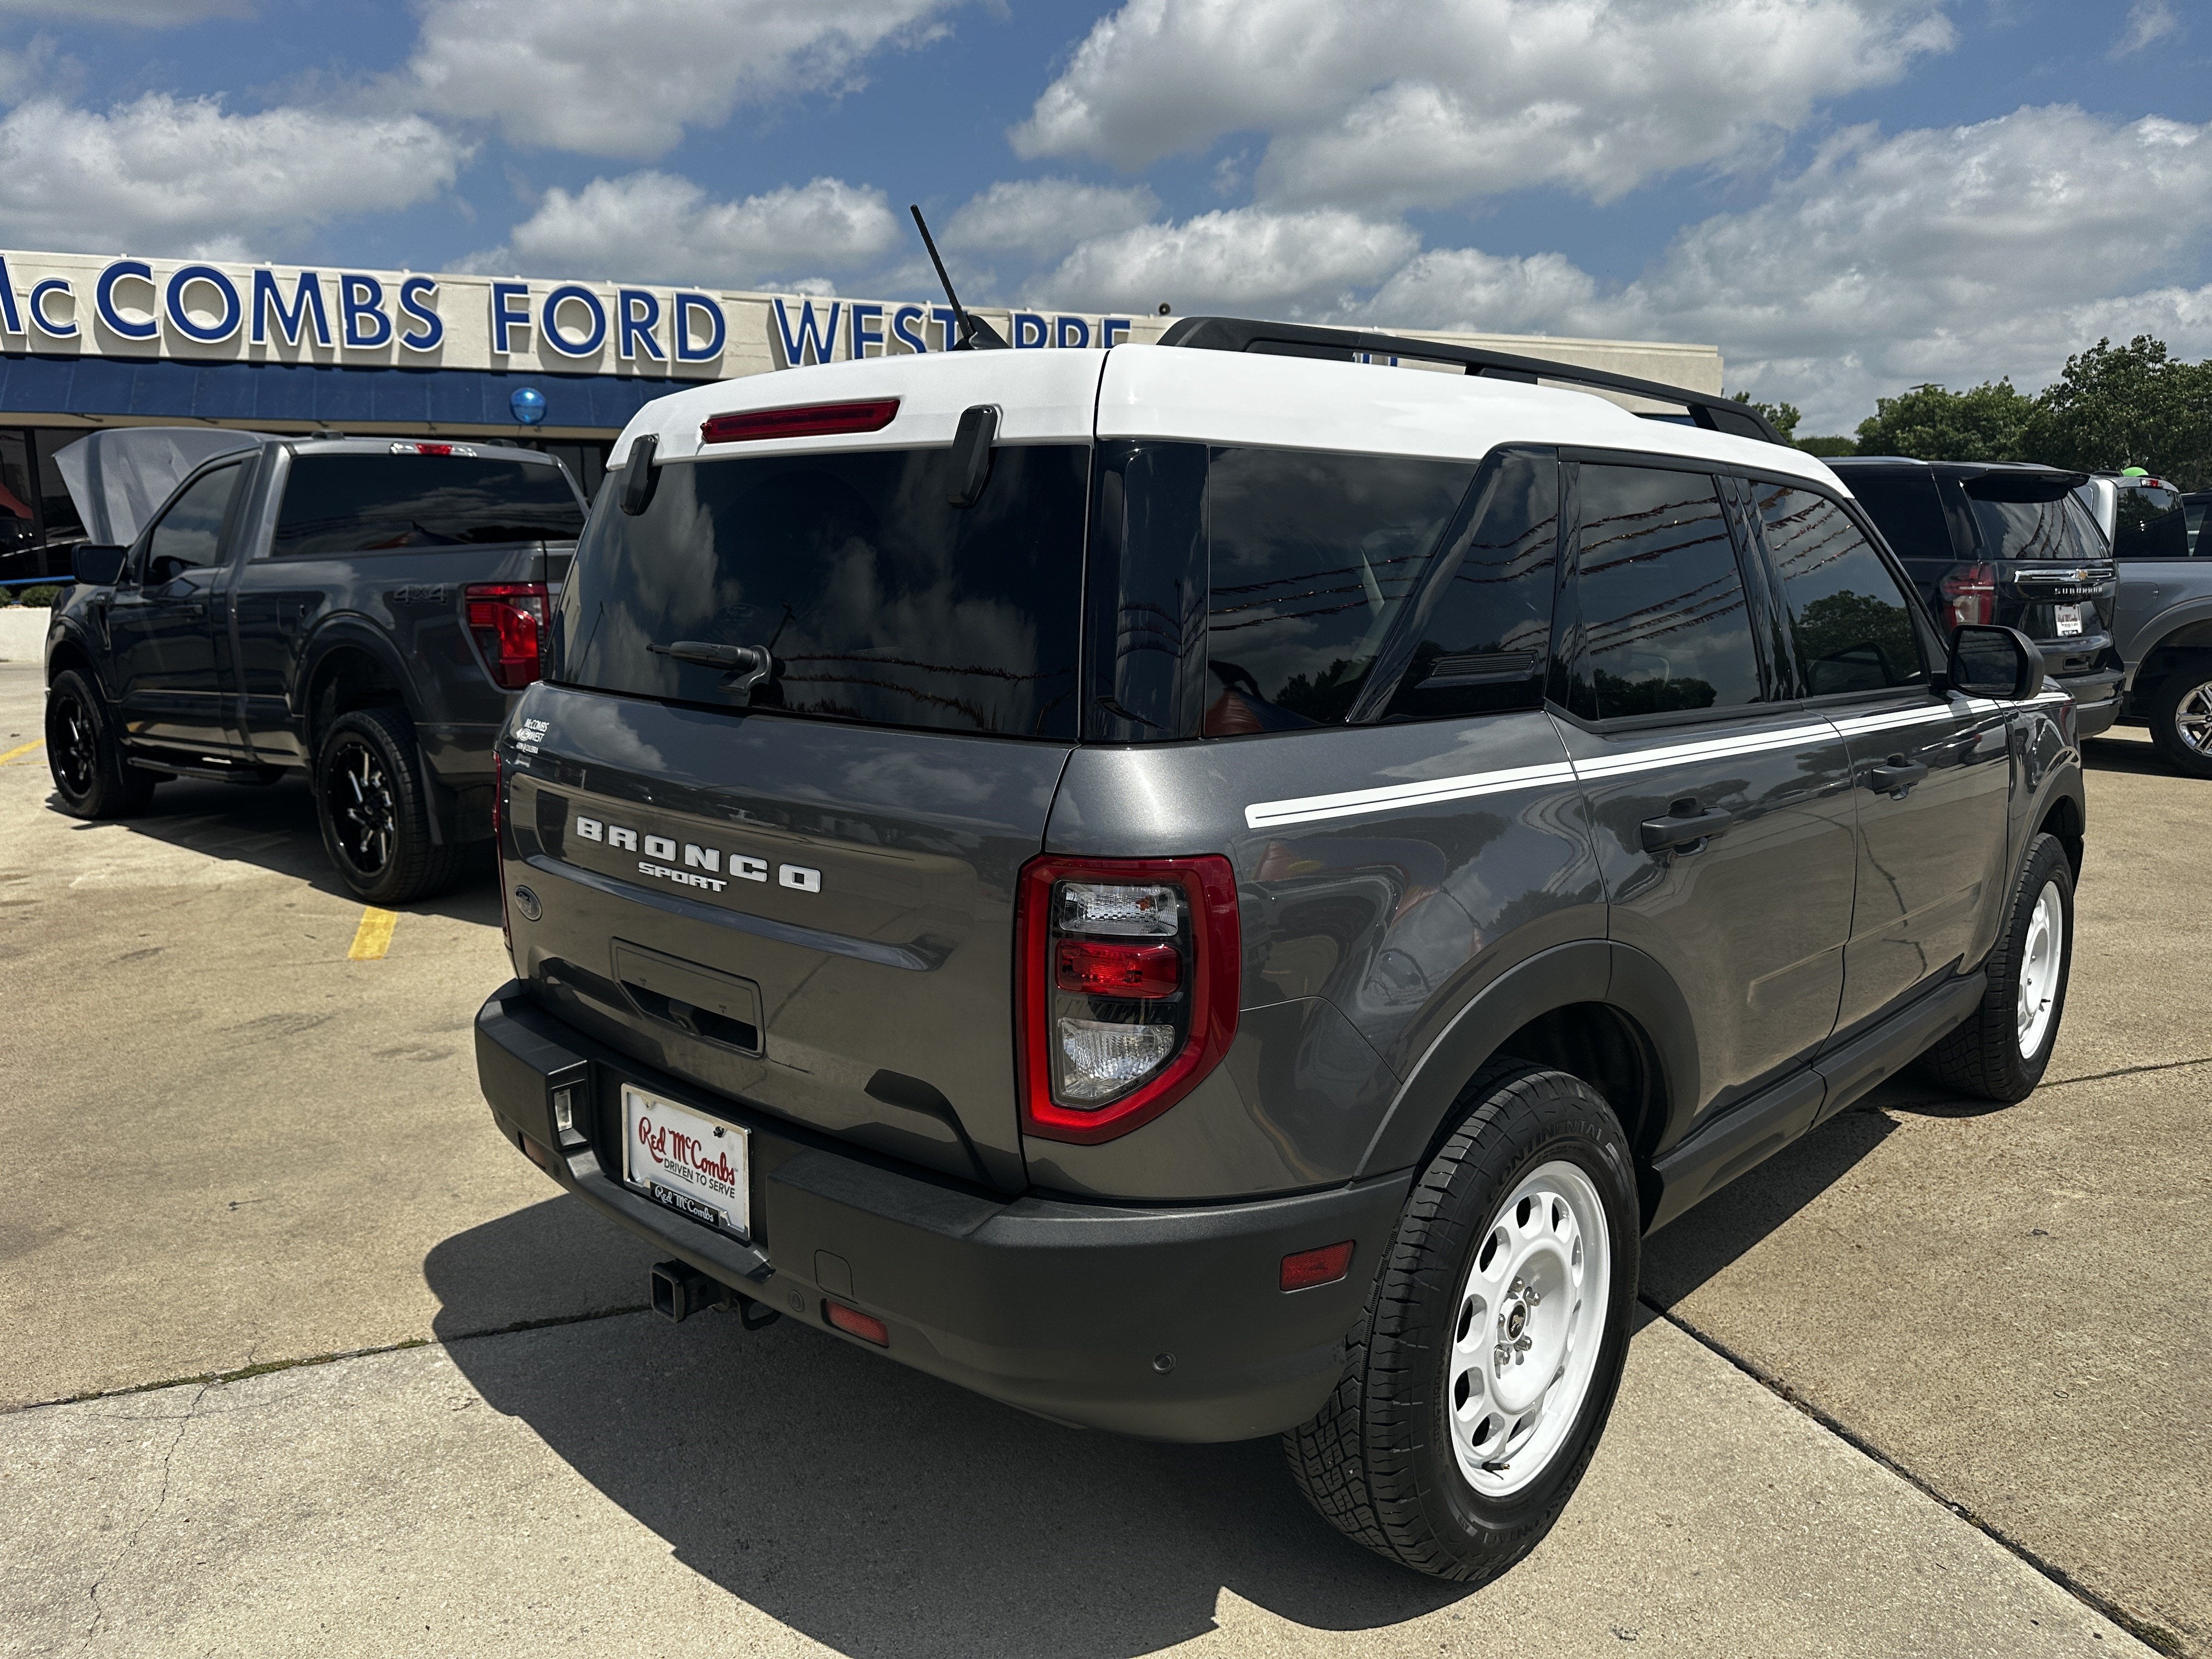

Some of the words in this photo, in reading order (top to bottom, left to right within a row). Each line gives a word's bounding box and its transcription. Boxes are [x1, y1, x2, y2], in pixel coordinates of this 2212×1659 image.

[490, 280, 727, 363] FORD
[771, 297, 966, 368] WEST
[577, 816, 821, 893] BRONCO
[639, 861, 727, 892] SPORT
[639, 1116, 667, 1164] Red
[668, 1127, 736, 1186] McCombs
[663, 1158, 693, 1180] DRIVEN
[696, 1172, 707, 1186] TO
[709, 1178, 736, 1199] SERVE
[1486, 1119, 1603, 1204] CONTINENTAL
[654, 1184, 673, 1204] Red
[673, 1193, 714, 1222] McCombs
